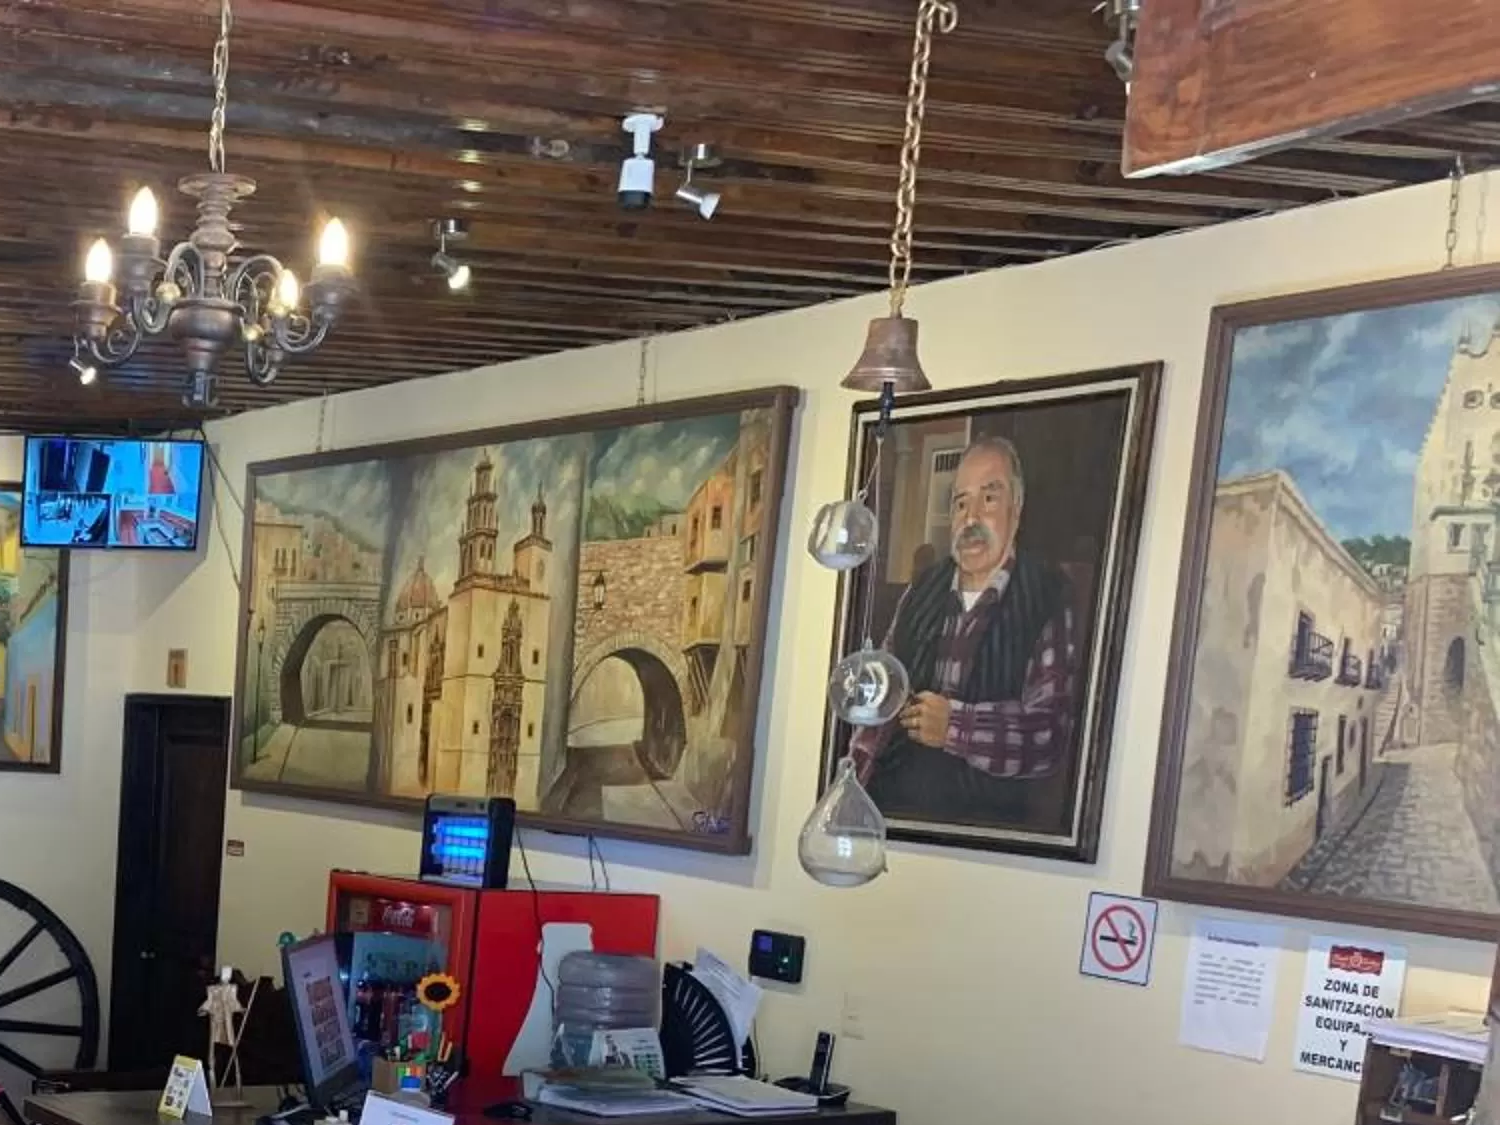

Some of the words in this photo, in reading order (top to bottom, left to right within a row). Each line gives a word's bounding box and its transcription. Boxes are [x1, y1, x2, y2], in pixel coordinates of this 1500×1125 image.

[1324, 979, 1359, 997] ZONA
[1362, 985, 1380, 999] DE
[1315, 1016, 1376, 1041] EQUIPA
[1339, 1039, 1349, 1052] Y
[1300, 1051, 1362, 1073] MERCANC
